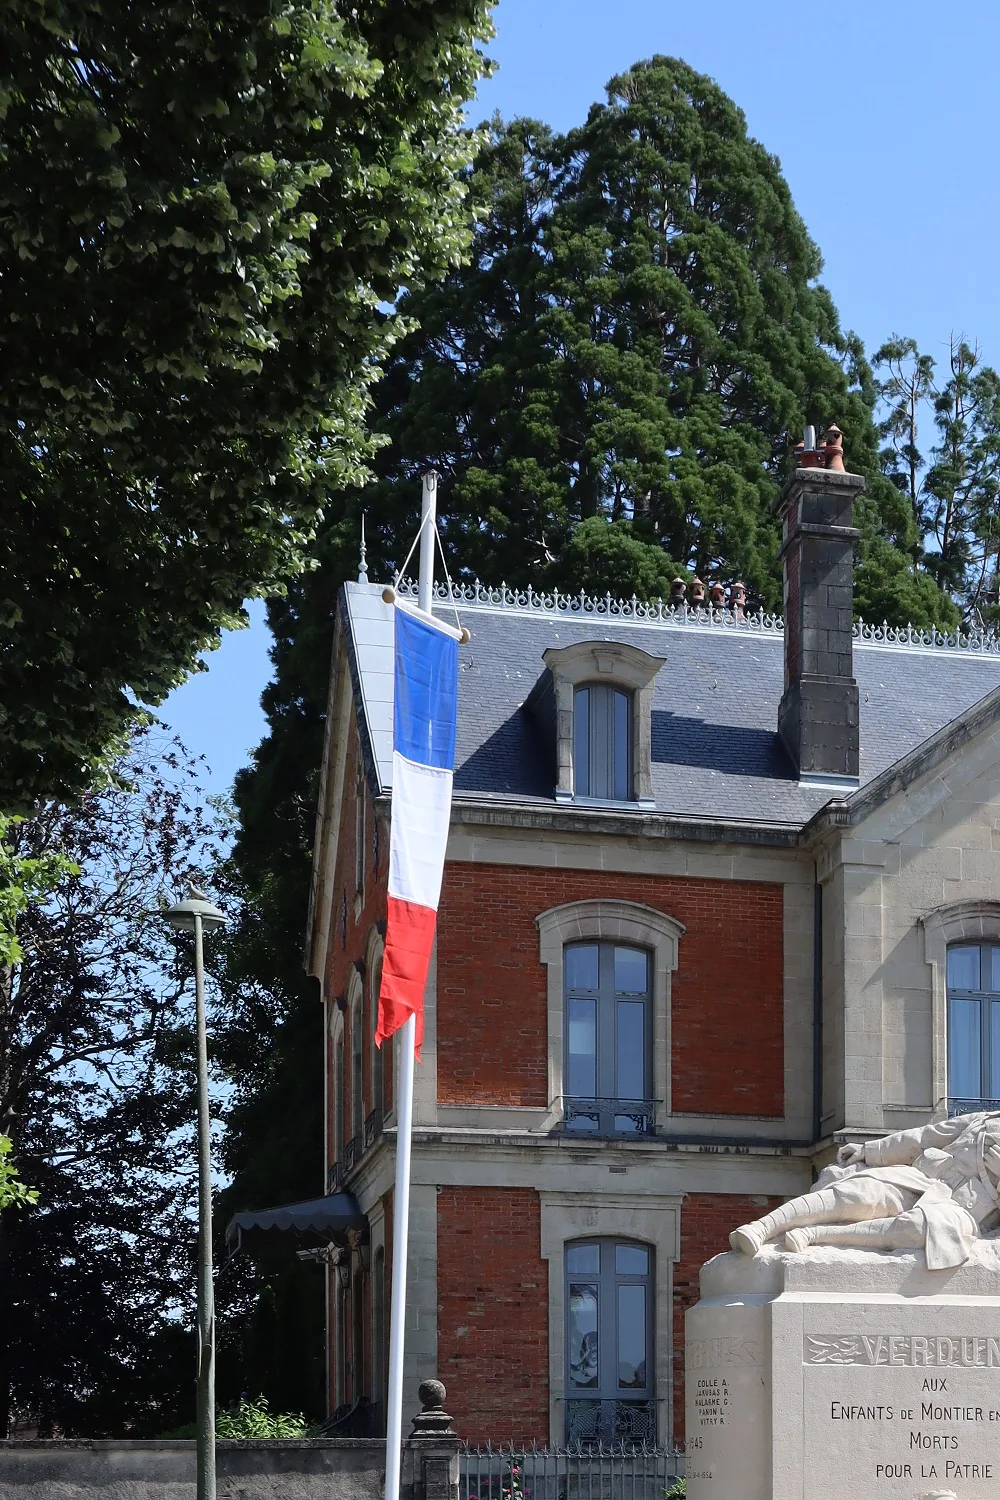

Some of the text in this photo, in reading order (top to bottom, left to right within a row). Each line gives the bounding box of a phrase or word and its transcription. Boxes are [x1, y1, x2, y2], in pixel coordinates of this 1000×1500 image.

[697, 1379, 718, 1388] COLLE
[921, 1378, 948, 1392] AUX
[831, 1401, 894, 1420] ENFANTS
[900, 1409, 914, 1420] DE
[921, 1402, 984, 1421] MONTIER
[909, 1431, 959, 1449] MORTS
[876, 1460, 993, 1478] POUR LA PATRIE
